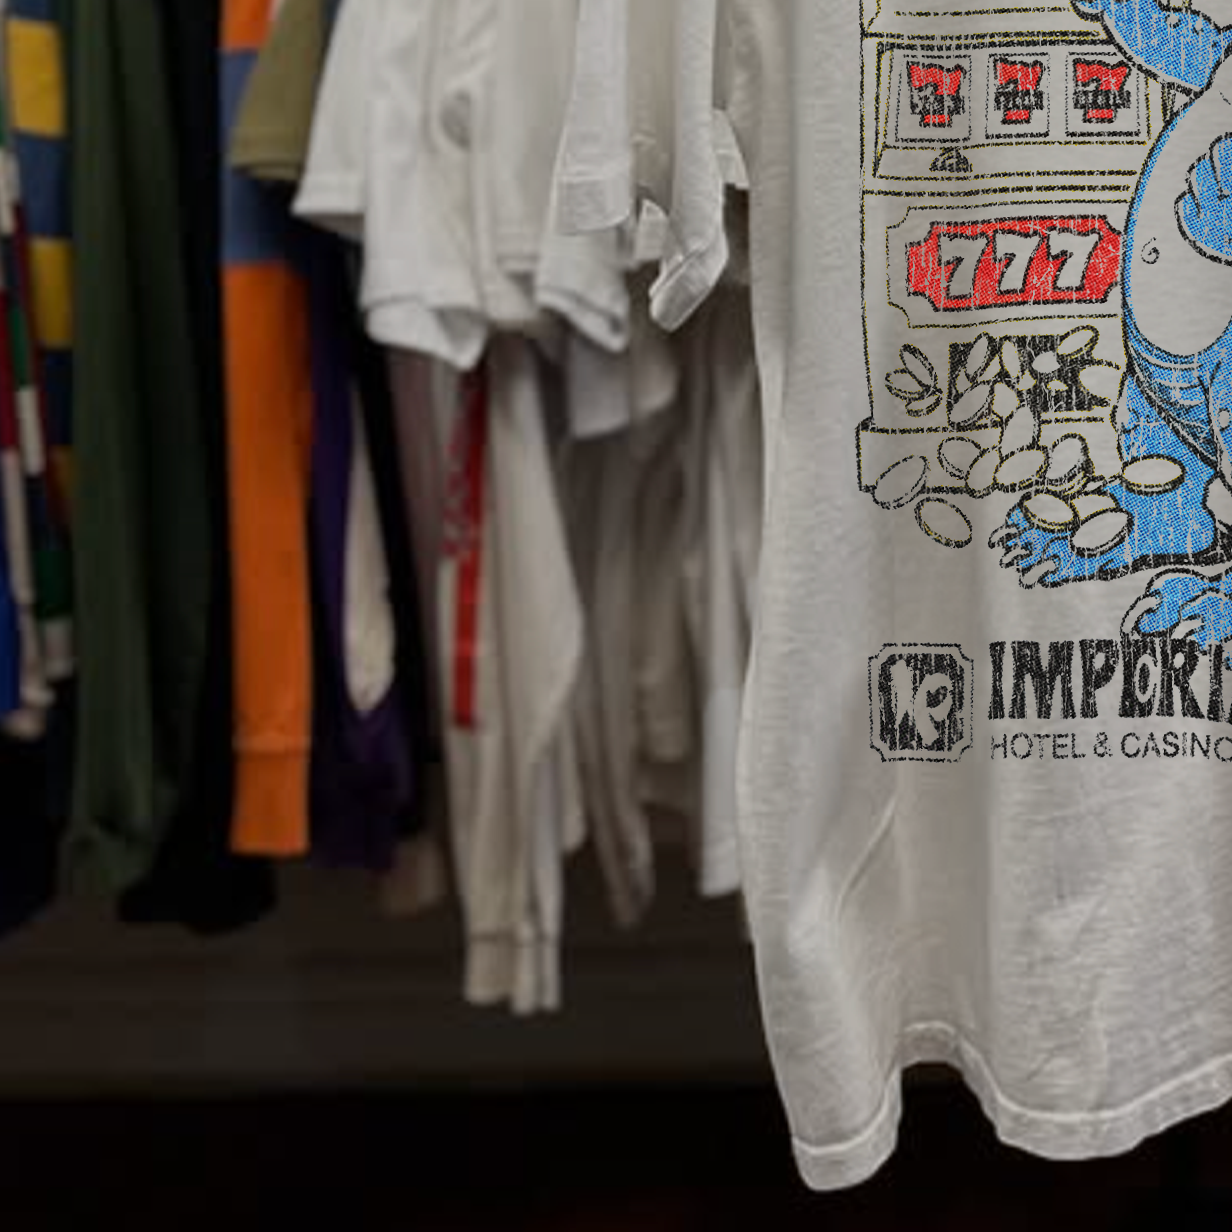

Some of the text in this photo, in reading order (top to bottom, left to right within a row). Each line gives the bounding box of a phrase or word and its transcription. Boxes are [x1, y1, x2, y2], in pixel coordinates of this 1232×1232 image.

[938, 226, 1104, 301] 777
[990, 731, 1086, 760] HOTEL
[1093, 730, 1113, 760] &
